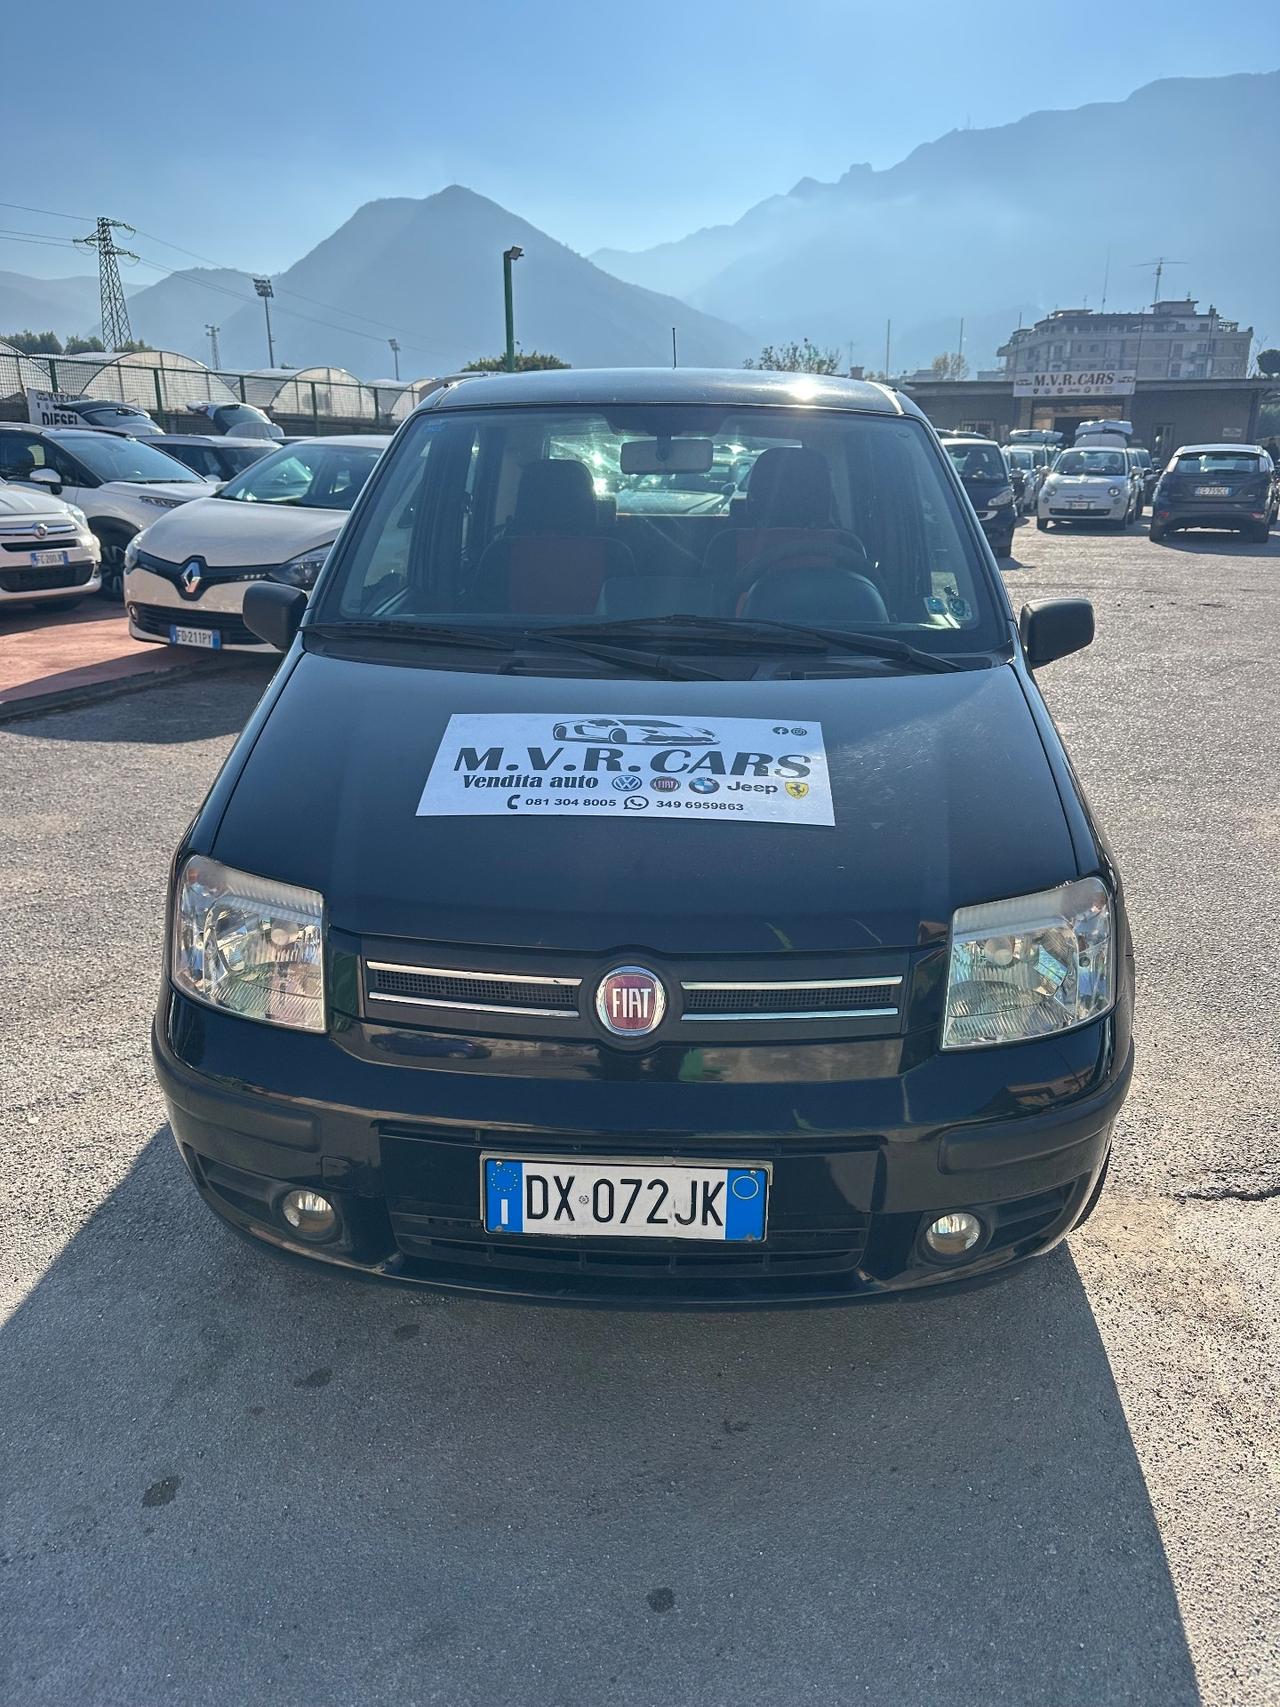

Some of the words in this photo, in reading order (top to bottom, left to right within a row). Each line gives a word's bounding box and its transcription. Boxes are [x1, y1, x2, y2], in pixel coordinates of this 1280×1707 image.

[41, 411, 78, 426] DIESEL
[463, 774, 543, 789] Vendita
[549, 775, 599, 789] auto
[727, 781, 778, 795] Jeep
[525, 798, 550, 807] 081
[554, 798, 579, 807] 304
[583, 798, 616, 807] 8005
[656, 800, 682, 809] 349
[685, 801, 744, 811] 6959863
[612, 987, 652, 1019] FIAT
